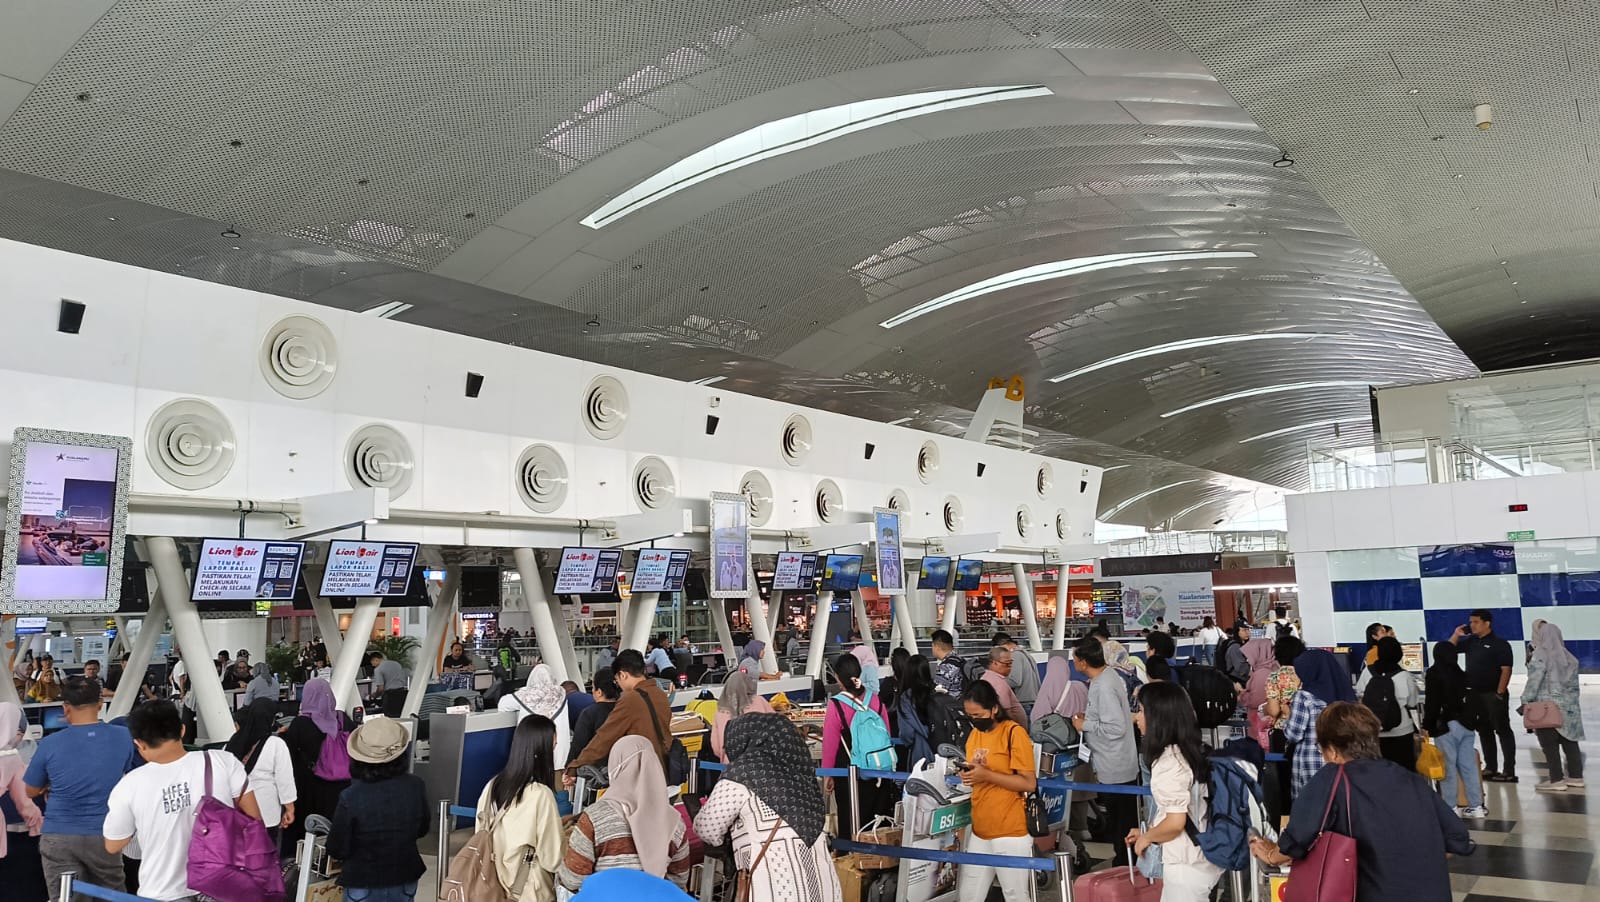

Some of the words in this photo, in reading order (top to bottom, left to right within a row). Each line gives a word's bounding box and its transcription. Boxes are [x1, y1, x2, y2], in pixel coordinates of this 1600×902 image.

[208, 547, 232, 555] Lion
[243, 547, 259, 556] air
[335, 548, 355, 556] Lion
[365, 549, 379, 557] air
[162, 784, 183, 801] LIFE
[184, 782, 189, 794] &
[164, 794, 191, 814] DEATH
[939, 813, 955, 830] BSI
